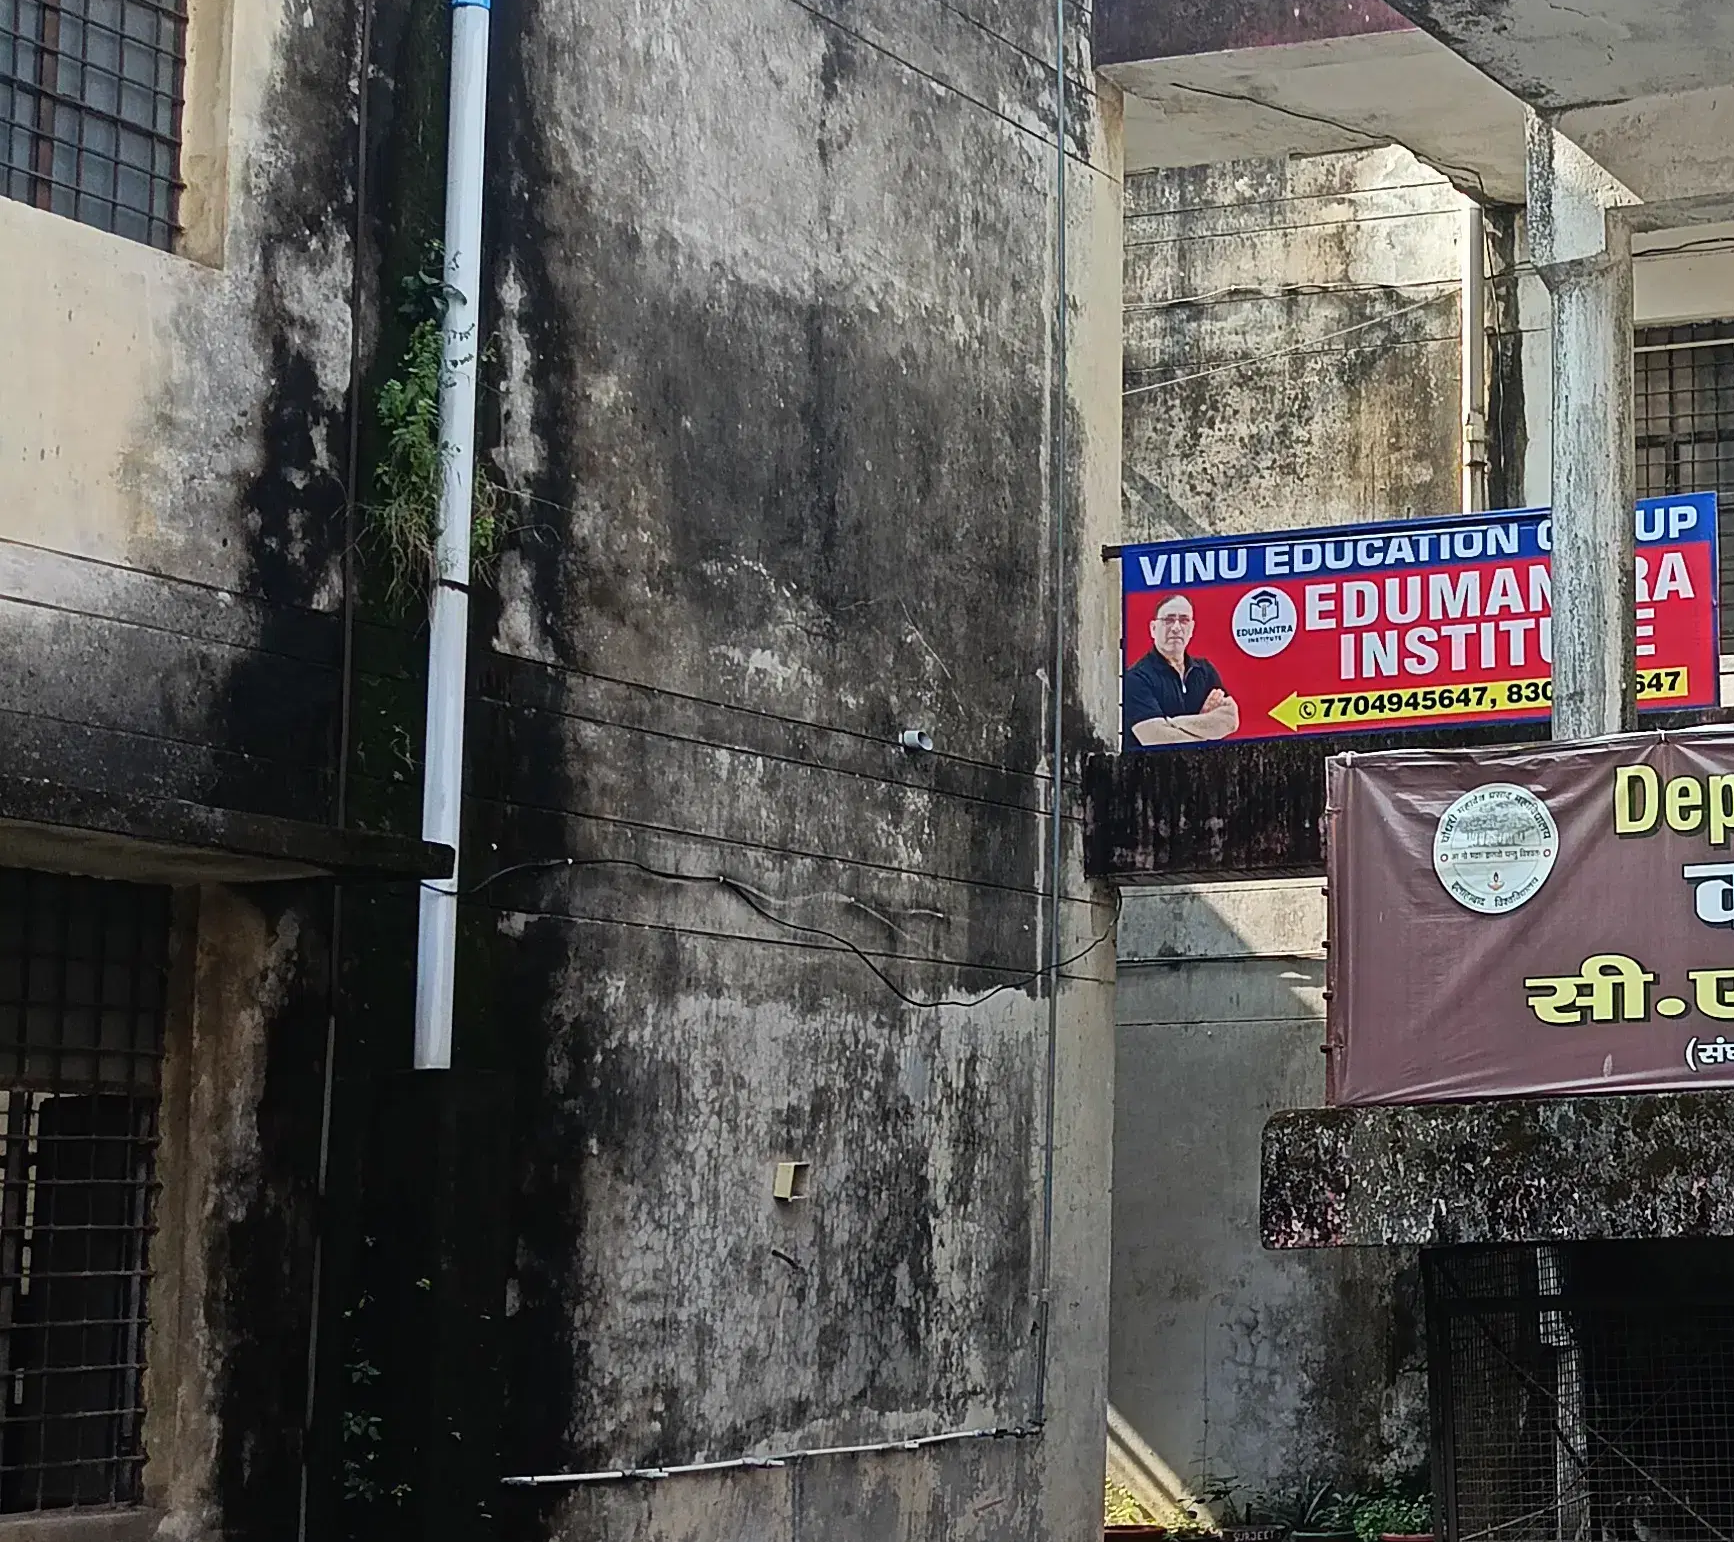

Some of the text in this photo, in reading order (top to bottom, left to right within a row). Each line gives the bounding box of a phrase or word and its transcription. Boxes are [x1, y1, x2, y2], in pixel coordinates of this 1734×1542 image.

[1139, 548, 1248, 586] VINU
[1265, 523, 1519, 575] EDUCATION
[1305, 552, 1695, 631] EDUMANA
[1236, 625, 1293, 637] EDUMANTRA
[1340, 607, 1656, 680] INSTITE
[1321, 687, 1497, 719] 7704945647,
